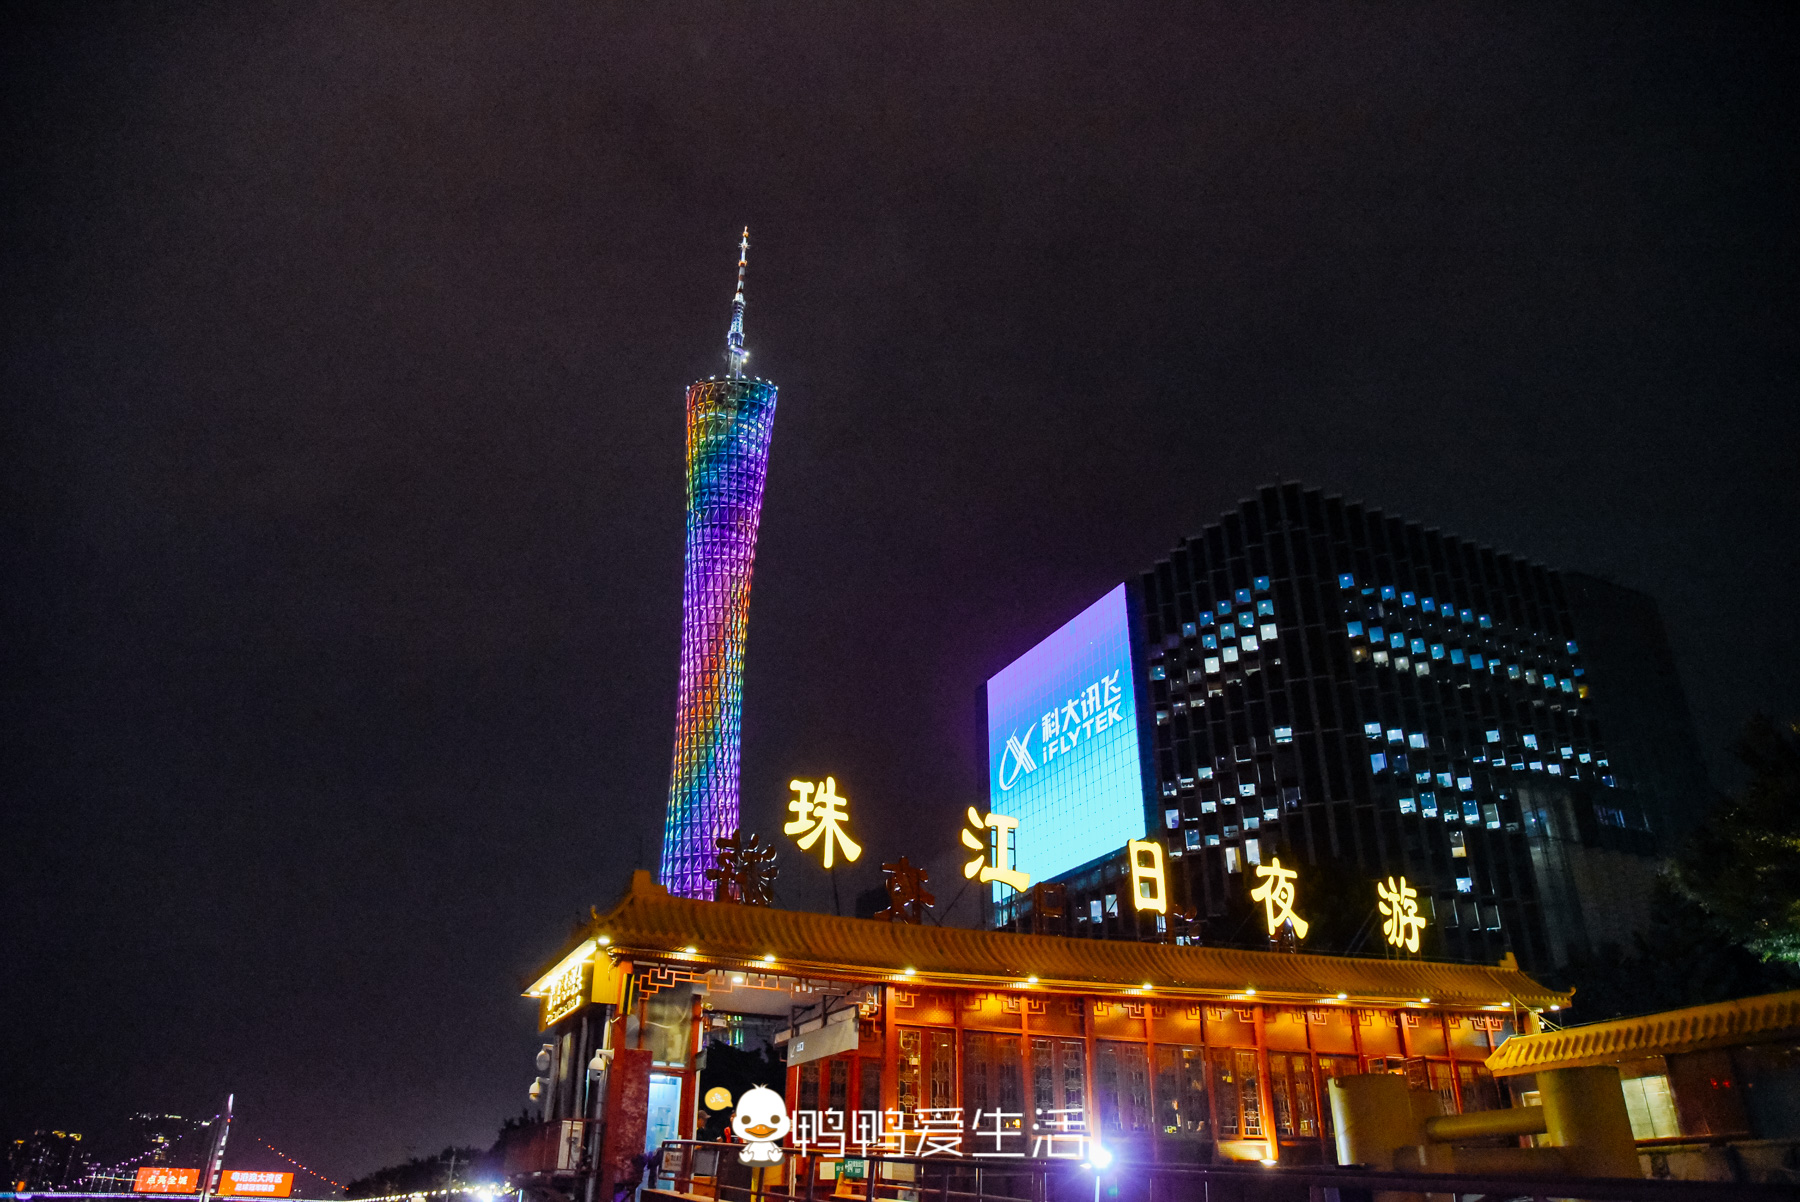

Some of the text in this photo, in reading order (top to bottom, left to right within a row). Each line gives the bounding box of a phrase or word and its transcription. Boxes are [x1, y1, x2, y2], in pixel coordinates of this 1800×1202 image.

[1042, 669, 1122, 743] 科大讯飞
[1042, 701, 1124, 764] iFLYTEK
[784, 776, 1426, 953] 珠江日夜游
[146, 1175, 189, 1185] 点亮全城
